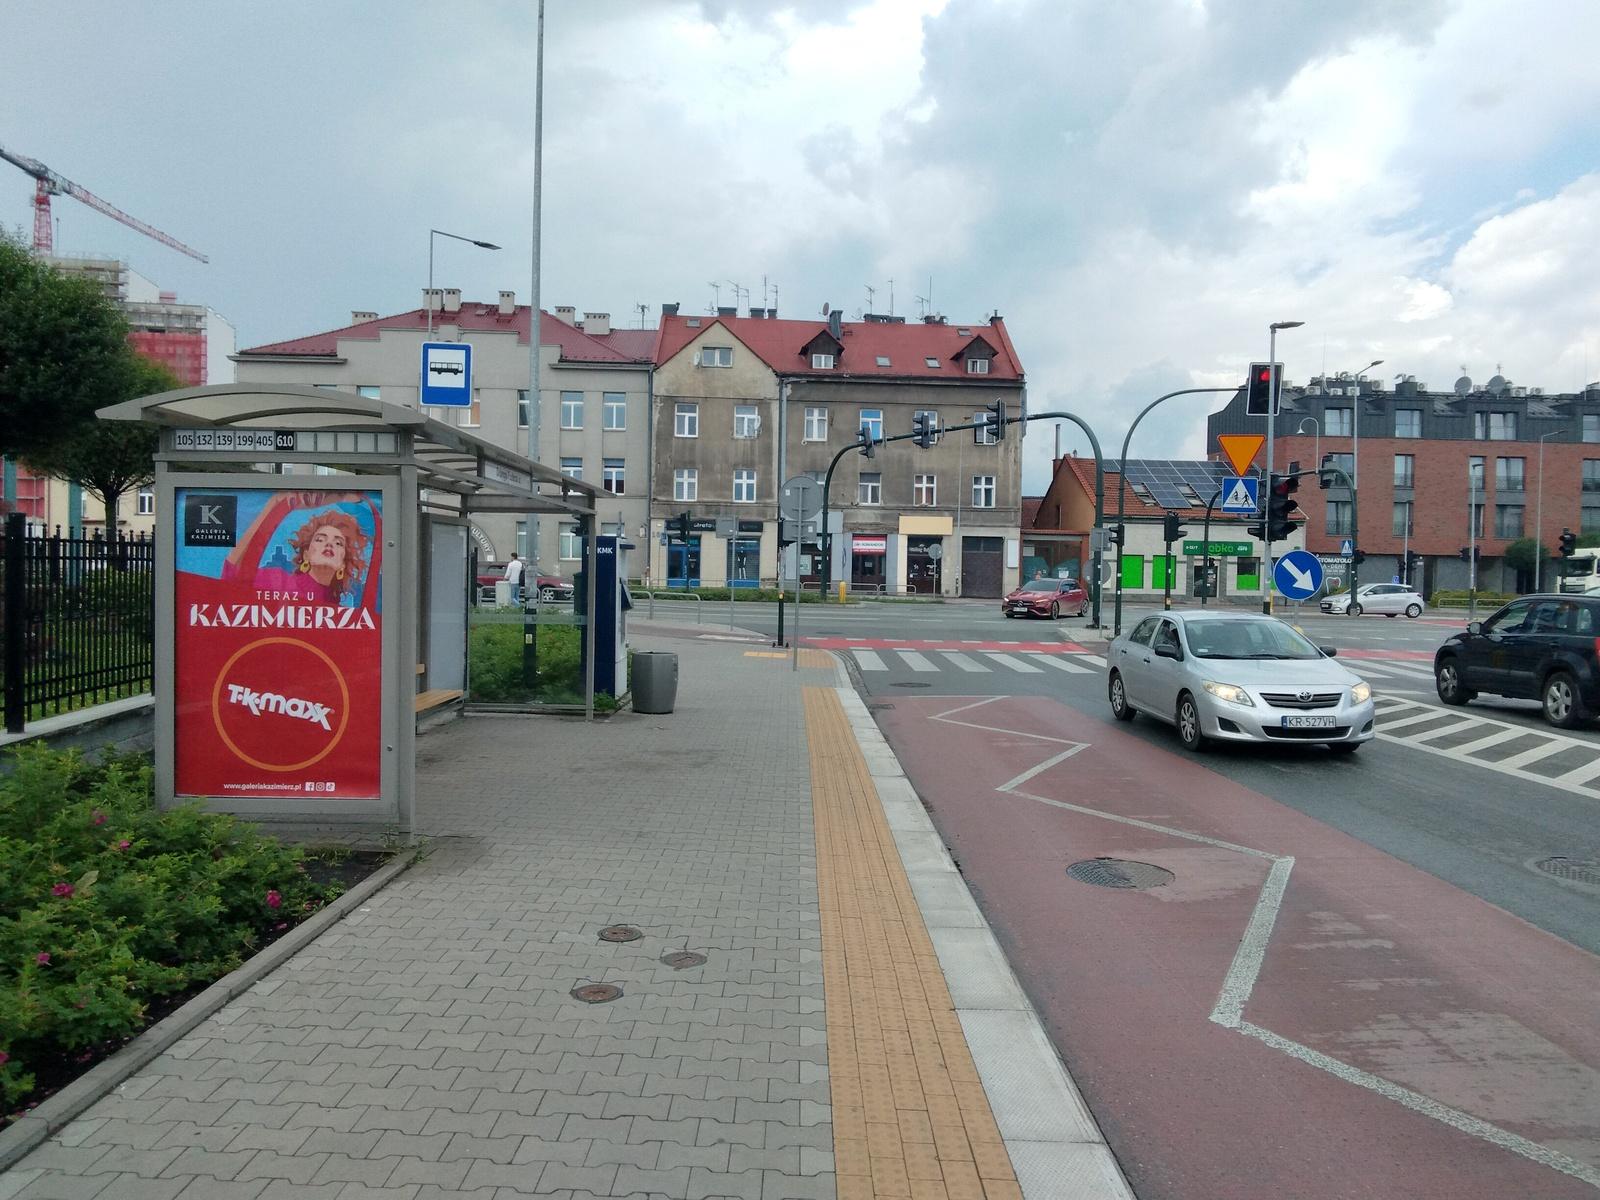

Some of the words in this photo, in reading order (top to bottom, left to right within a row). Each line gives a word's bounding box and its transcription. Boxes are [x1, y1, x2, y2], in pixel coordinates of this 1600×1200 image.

[177, 434, 193, 446] 105
[196, 434, 213, 446] 132
[216, 434, 233, 446] 139
[237, 435, 254, 447] 199
[256, 435, 273, 447] 405
[276, 435, 294, 447] 610
[200, 505, 223, 525] K
[1207, 543, 1234, 553] abka
[256, 591, 299, 601] TERAZ
[307, 592, 315, 601] U
[190, 603, 376, 630] KAZIMIERZA
[1288, 717, 1303, 727] KR
[1305, 717, 1335, 727] 527VH
[223, 783, 302, 791] www.galeriakazimierz.pl
